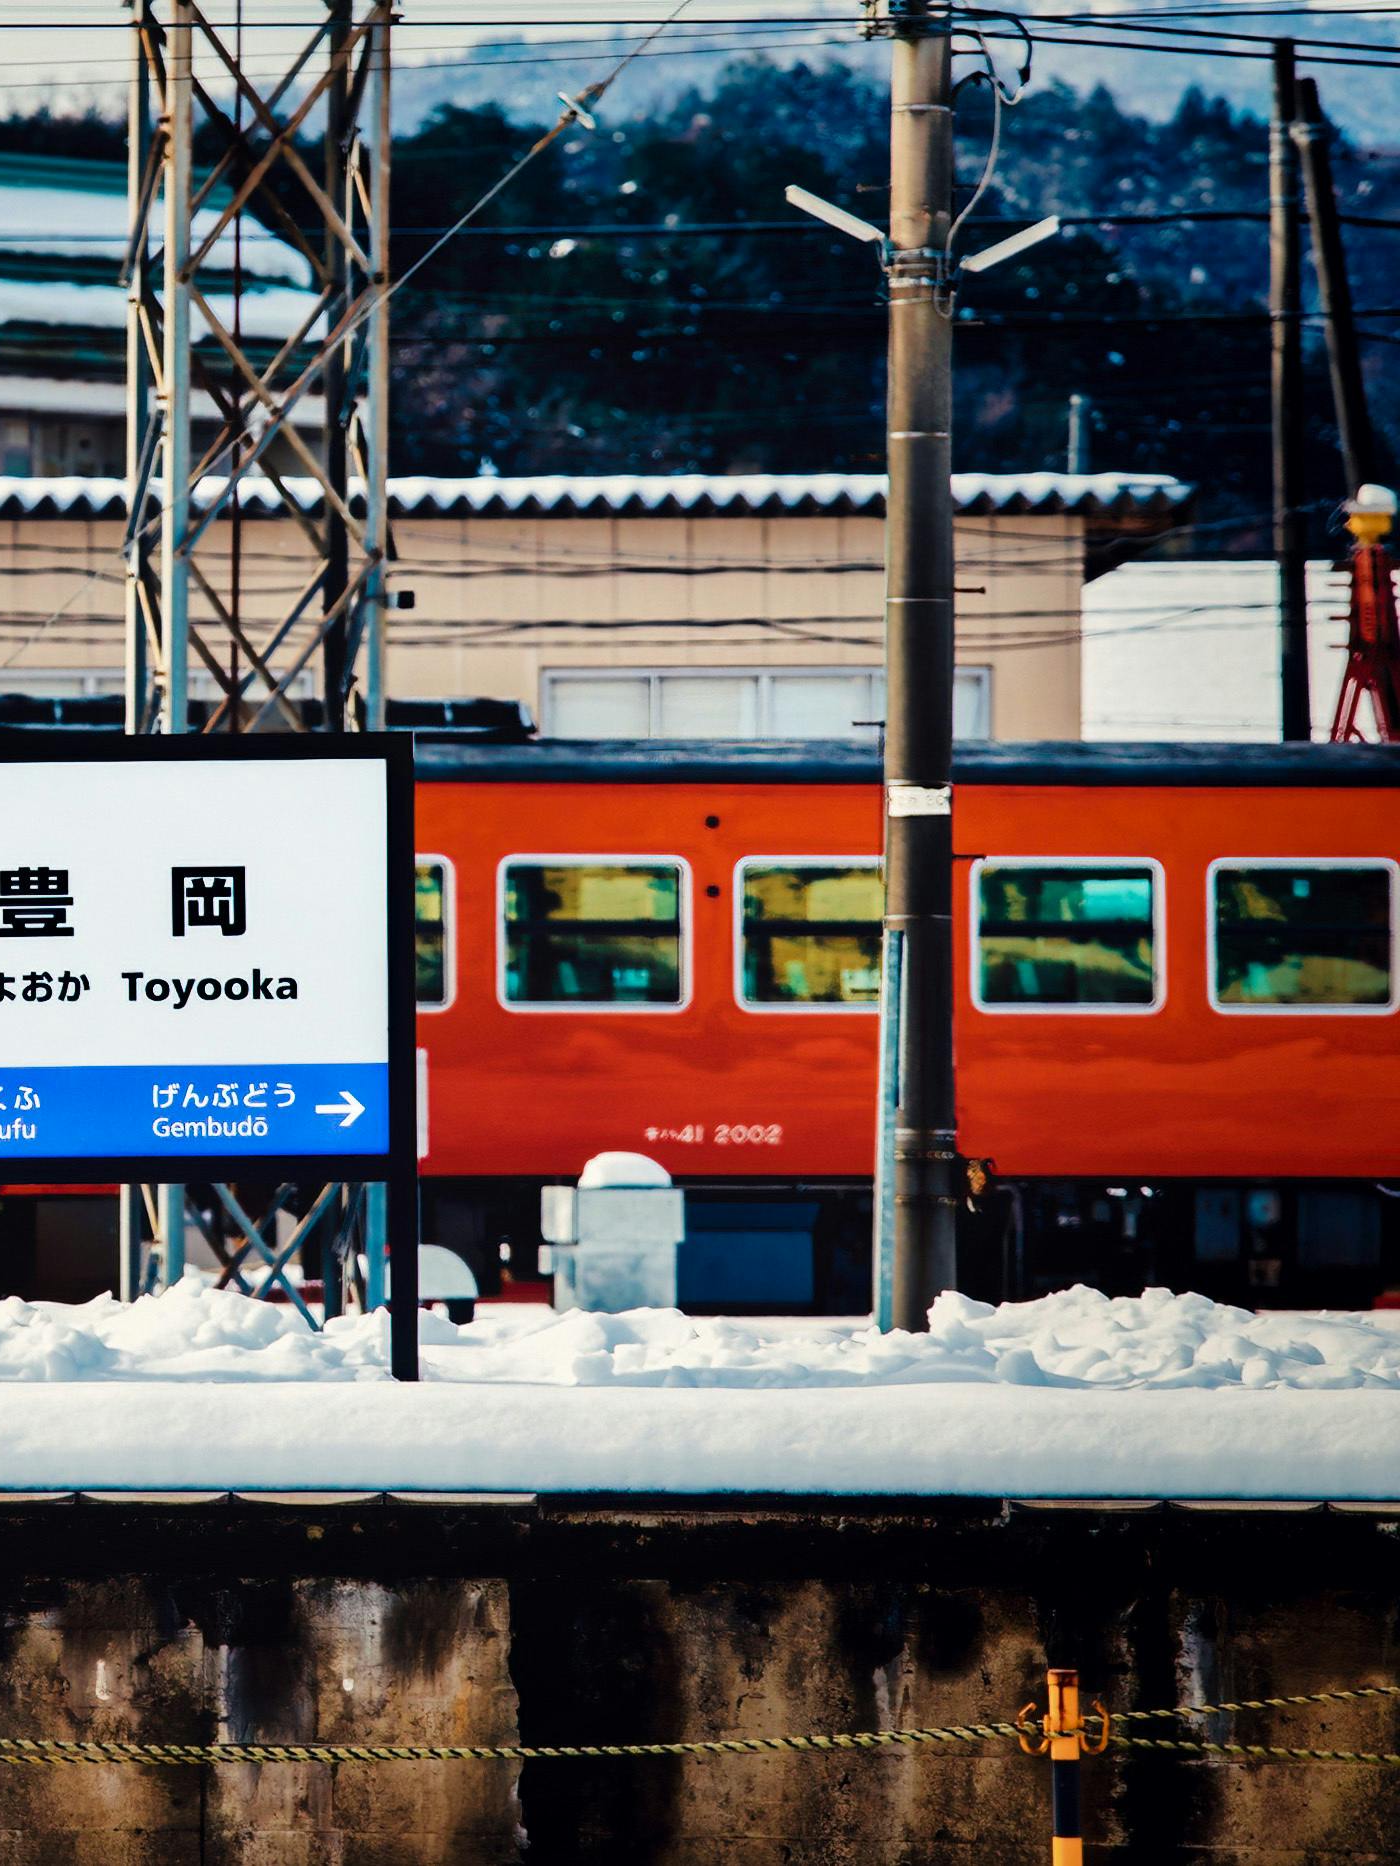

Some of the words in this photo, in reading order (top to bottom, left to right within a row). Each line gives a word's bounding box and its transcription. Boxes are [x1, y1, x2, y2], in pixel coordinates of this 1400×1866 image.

[121, 968, 298, 1010] Toyooka
[152, 1082, 296, 1109] げんぶどう
[152, 1114, 269, 1138] Gembudō
[713, 1123, 784, 1145] 2002
